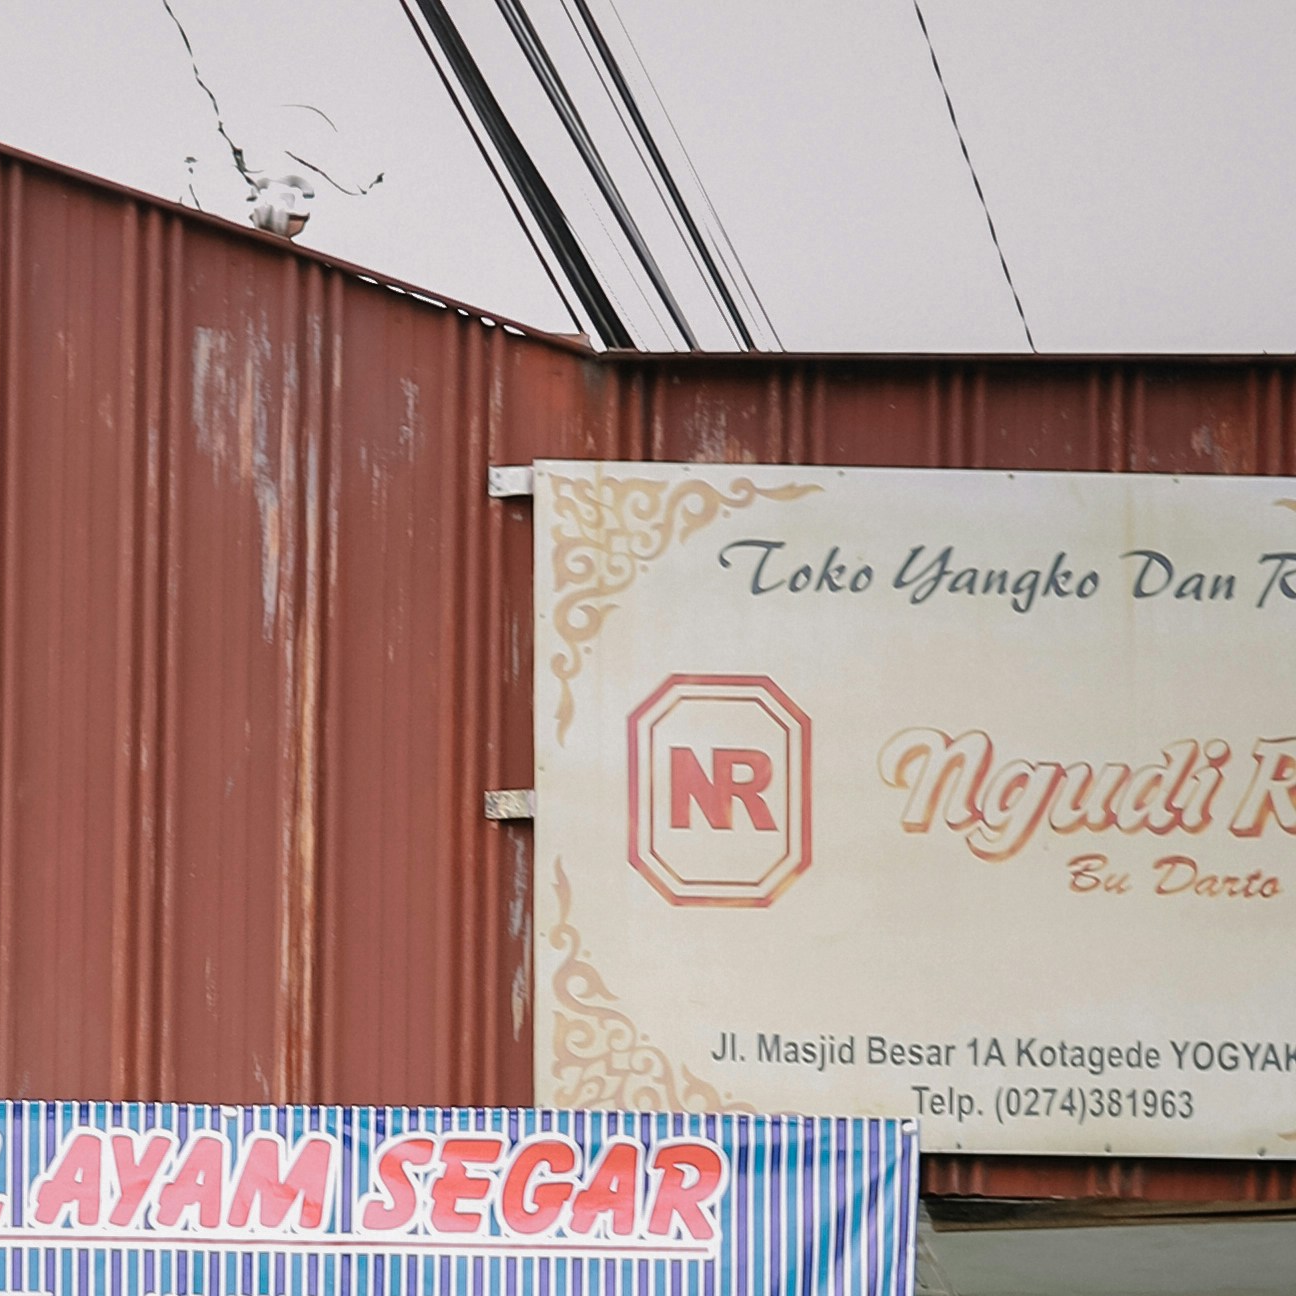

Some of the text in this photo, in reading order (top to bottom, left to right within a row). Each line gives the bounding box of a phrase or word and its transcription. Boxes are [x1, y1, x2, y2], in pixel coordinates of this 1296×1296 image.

[719, 540, 873, 596] Toko
[893, 543, 1099, 613] Yangko
[1119, 549, 1235, 601] Dan
[670, 747, 778, 831] NR
[878, 727, 1231, 862] Ngudi
[1066, 853, 1281, 899] Bu Darto
[712, 1032, 745, 1063] Jl.
[757, 1034, 854, 1071] Masjid
[867, 1036, 955, 1066] Besar
[967, 1038, 1007, 1067] 1A
[1016, 1038, 1160, 1075] Kotagede
[911, 1086, 1194, 1125] Telp. (0274)381963
[30, 1130, 337, 1232] AYAM
[364, 1133, 728, 1240] SEGAR
